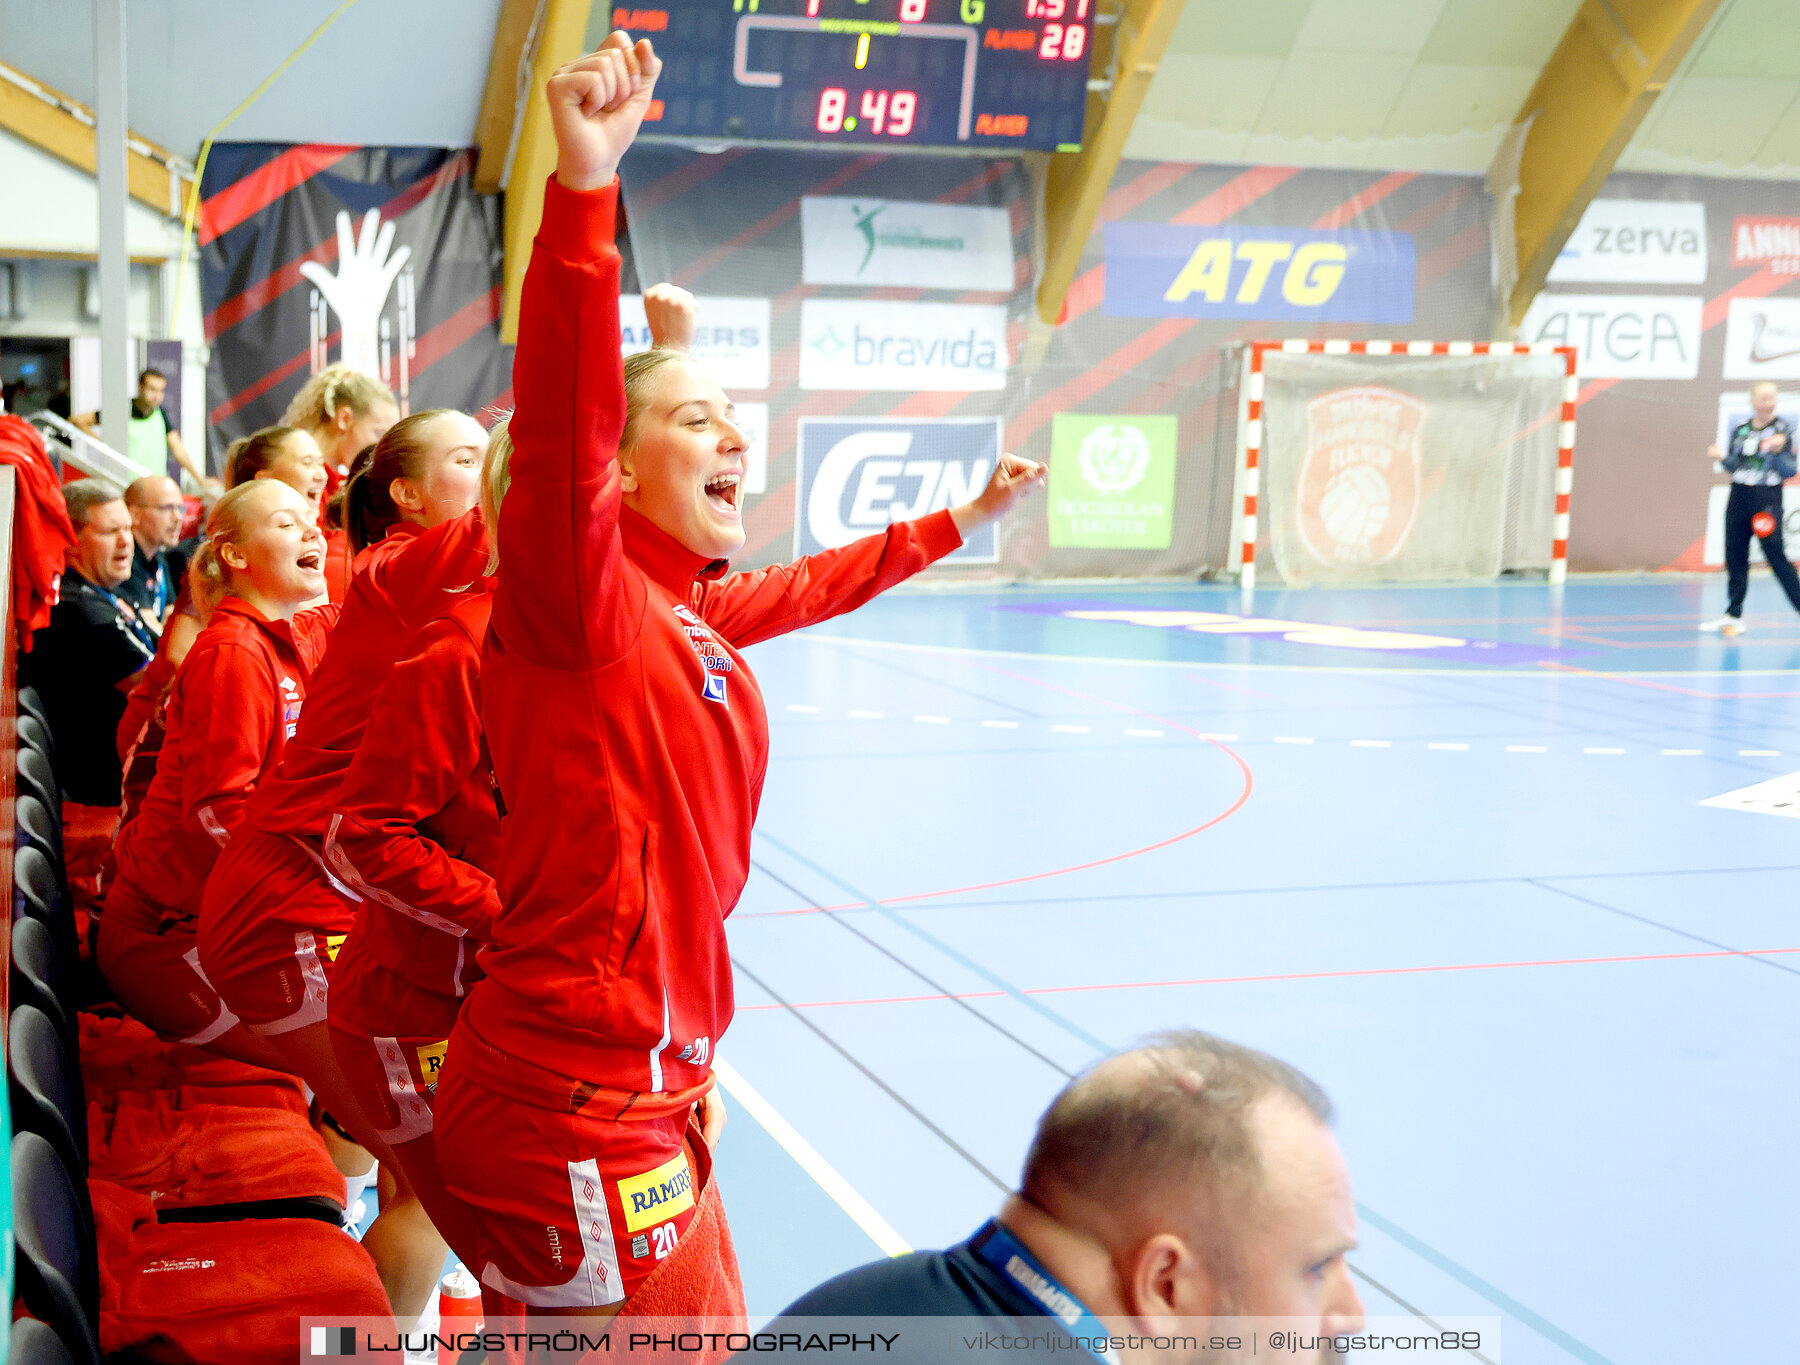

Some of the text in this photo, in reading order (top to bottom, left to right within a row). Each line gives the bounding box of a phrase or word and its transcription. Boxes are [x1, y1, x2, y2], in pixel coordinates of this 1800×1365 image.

[1038, 22, 1087, 61] 28
[975, 113, 1029, 137] PLAYER
[1593, 225, 1699, 256] zerva
[1163, 238, 1348, 307] ATG
[853, 324, 997, 370] bravida
[1535, 311, 1688, 363] ATEA
[279, 970, 292, 1003] umbro
[688, 1036, 709, 1065] 20
[652, 1221, 679, 1260] 20
